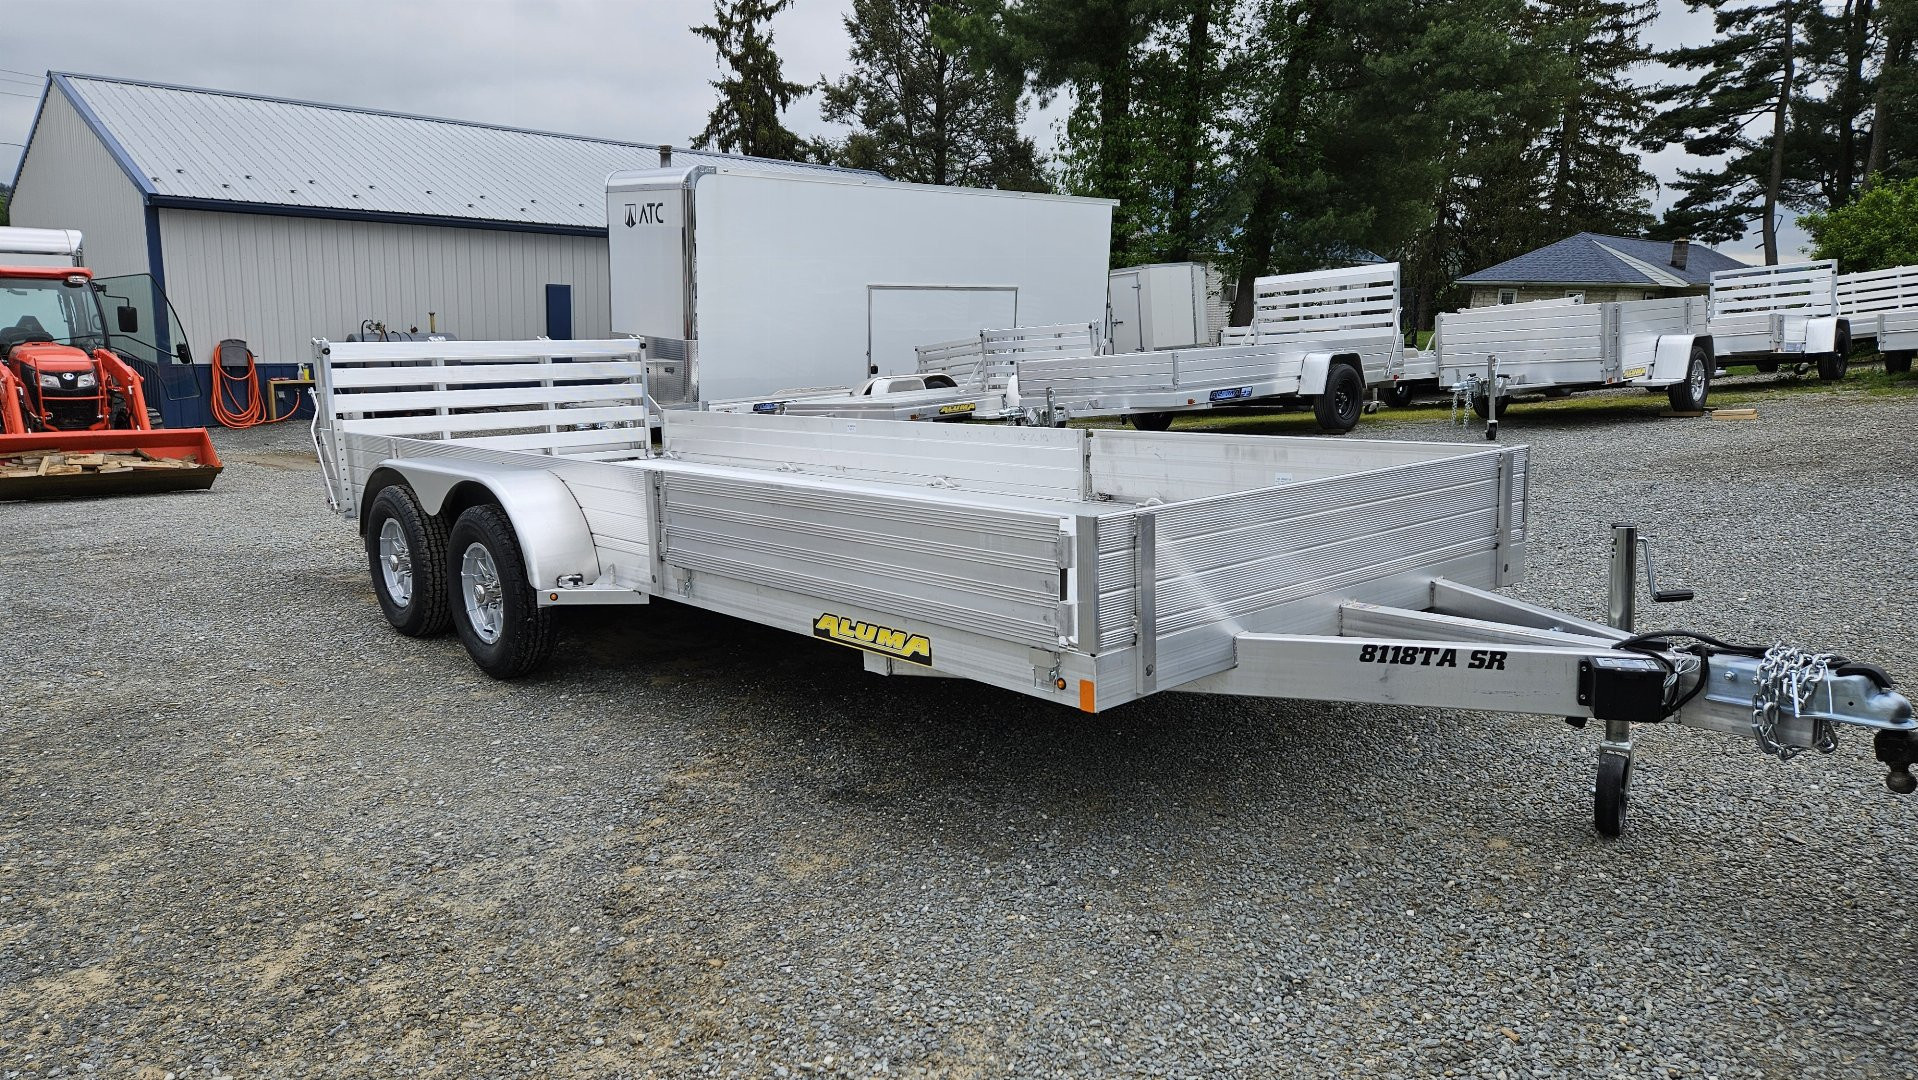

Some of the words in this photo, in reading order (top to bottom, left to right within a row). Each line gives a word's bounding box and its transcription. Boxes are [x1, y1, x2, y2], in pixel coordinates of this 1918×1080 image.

[639, 203, 664, 224] ATC
[939, 403, 975, 414] ALUMA
[815, 613, 931, 658] ALUMA
[1359, 644, 1457, 668] 8118TA
[1467, 650, 1508, 671] SR
